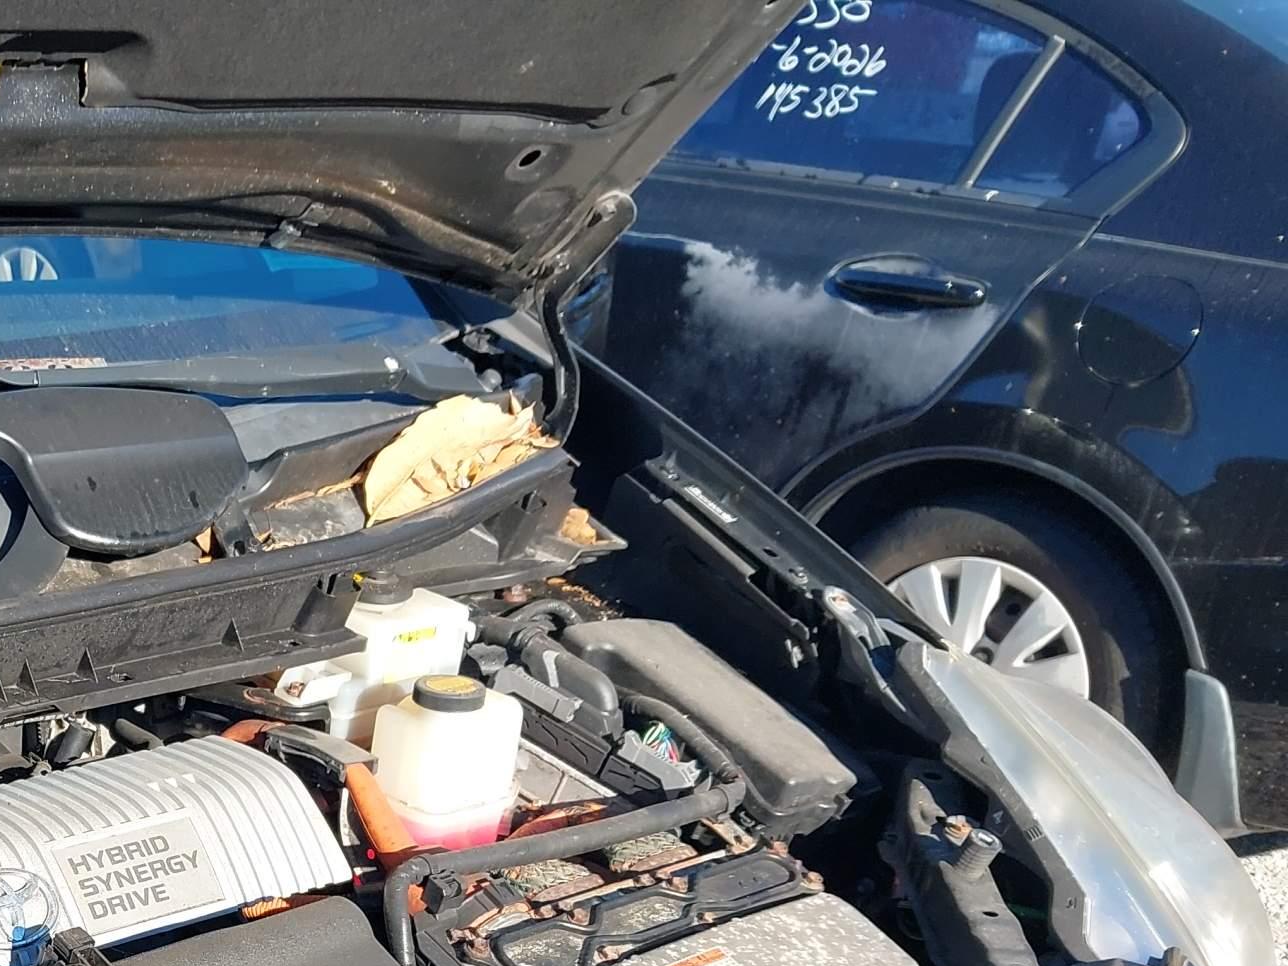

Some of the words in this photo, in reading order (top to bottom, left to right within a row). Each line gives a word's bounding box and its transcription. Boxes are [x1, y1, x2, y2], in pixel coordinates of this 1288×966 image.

[67, 835, 170, 875] HYBRID
[78, 849, 198, 898] SYNERGY
[87, 883, 170, 920] DRIVE
